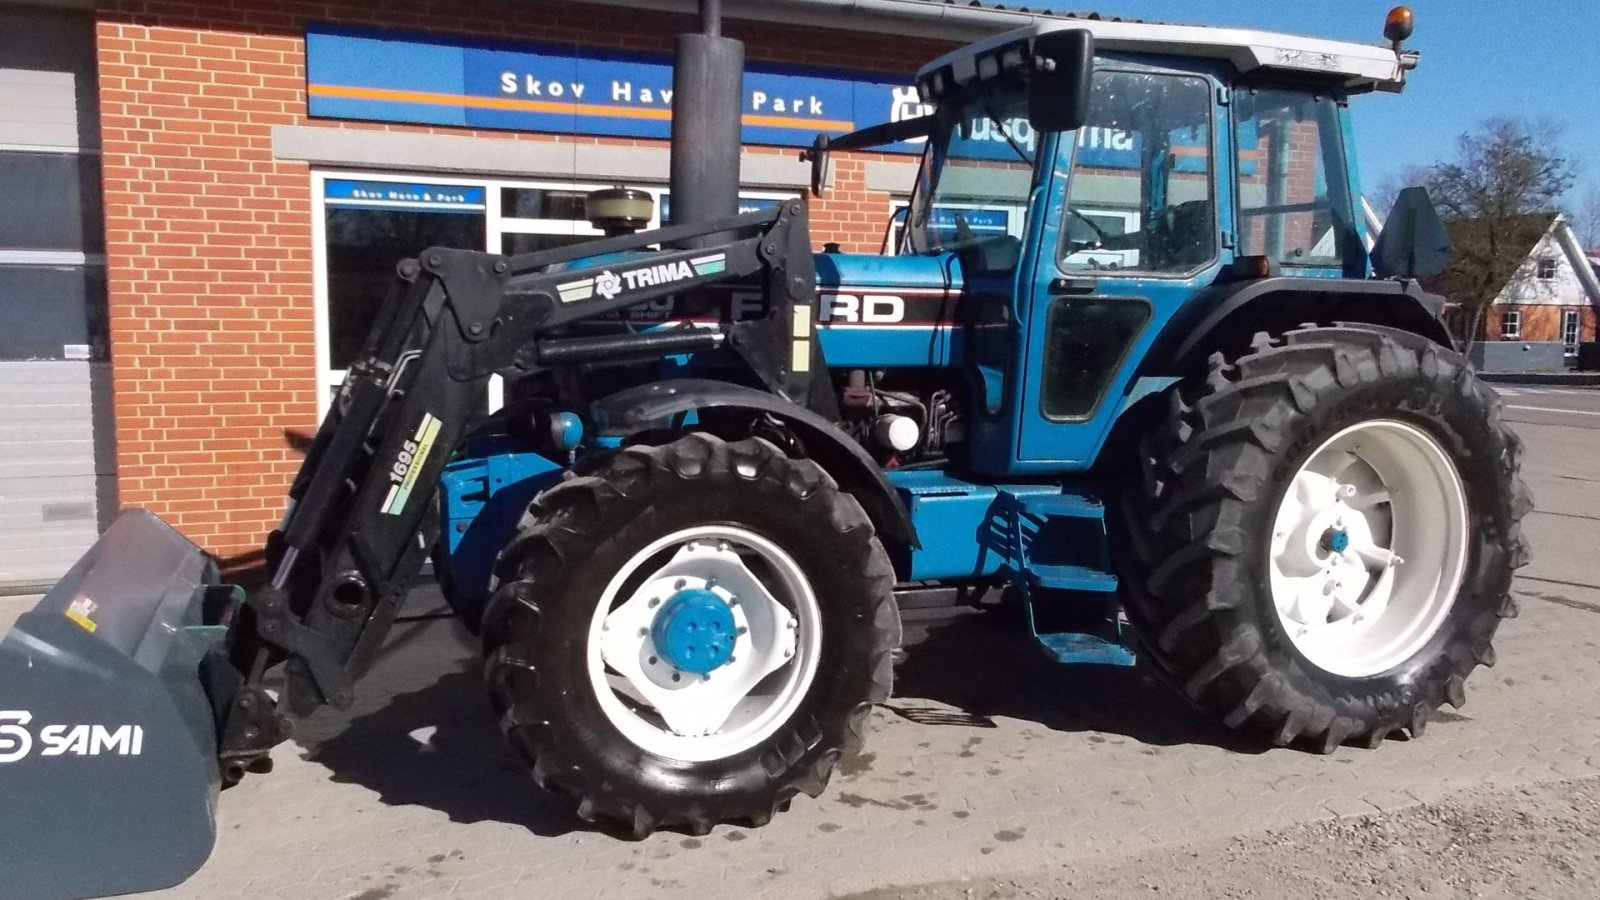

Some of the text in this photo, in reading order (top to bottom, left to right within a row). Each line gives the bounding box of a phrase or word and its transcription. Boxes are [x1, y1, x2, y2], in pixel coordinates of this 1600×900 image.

[501, 73, 823, 115] Skov Hav Park
[621, 260, 694, 290] TRIMA
[731, 292, 905, 323] FRD
[389, 439, 418, 482] 1695
[40, 724, 144, 756] SAMI
